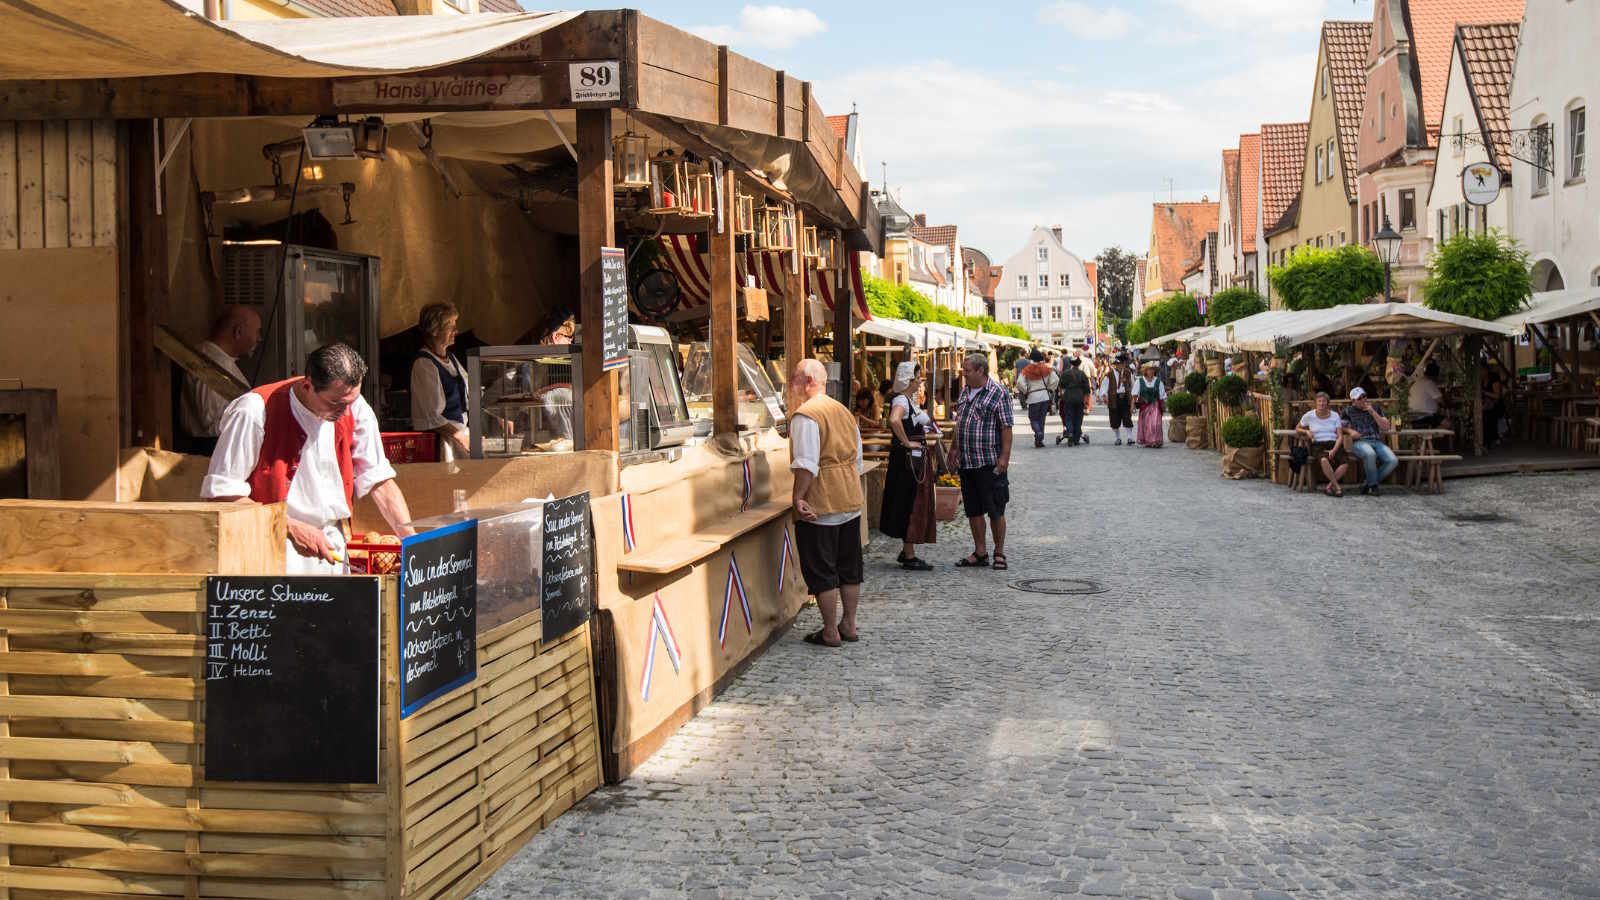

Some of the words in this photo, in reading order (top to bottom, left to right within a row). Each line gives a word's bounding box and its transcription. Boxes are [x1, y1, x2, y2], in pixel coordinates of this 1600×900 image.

[580, 66, 611, 87] 89
[375, 82, 425, 99] Hansi
[216, 581, 266, 602] Unsere
[270, 584, 335, 602] Schweine
[226, 604, 277, 619] Zenzi
[228, 621, 271, 640] Betti
[230, 643, 269, 661] Molli
[233, 664, 272, 678] Helena
